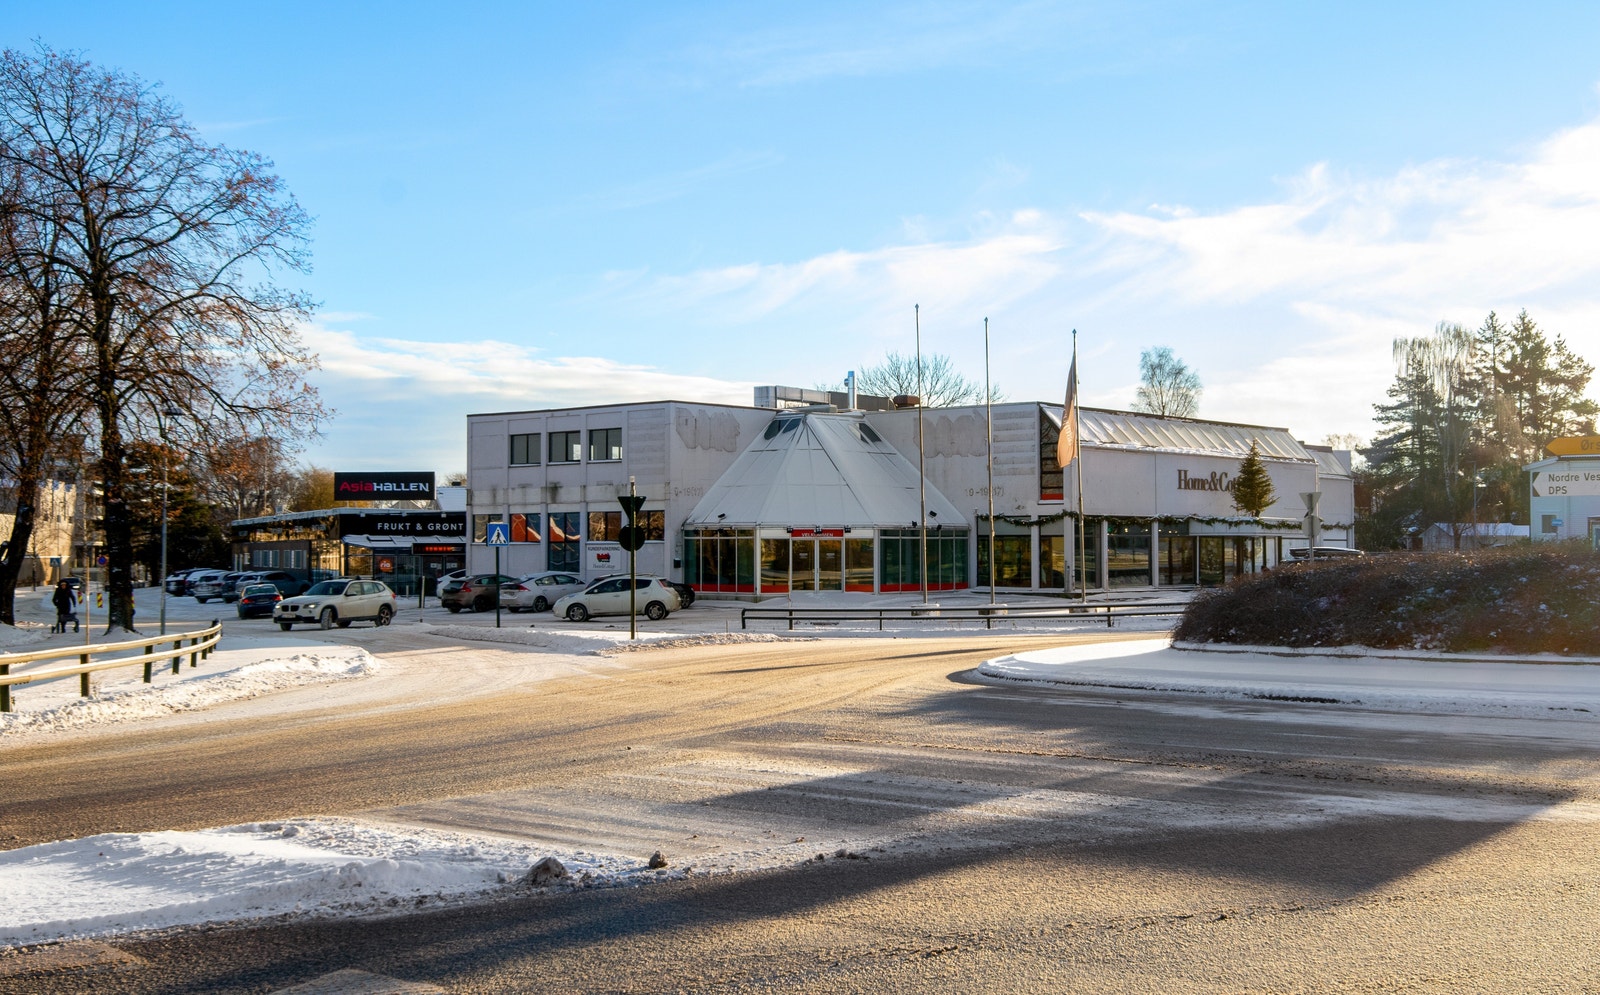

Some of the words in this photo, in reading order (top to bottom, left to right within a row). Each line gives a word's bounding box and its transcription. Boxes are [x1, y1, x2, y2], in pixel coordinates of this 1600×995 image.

[1548, 473, 1580, 482] Nordre
[1548, 486, 1568, 494] DPS
[377, 522, 411, 531] FRUKT
[415, 522, 423, 531] &
[427, 522, 464, 531] GRØNT
